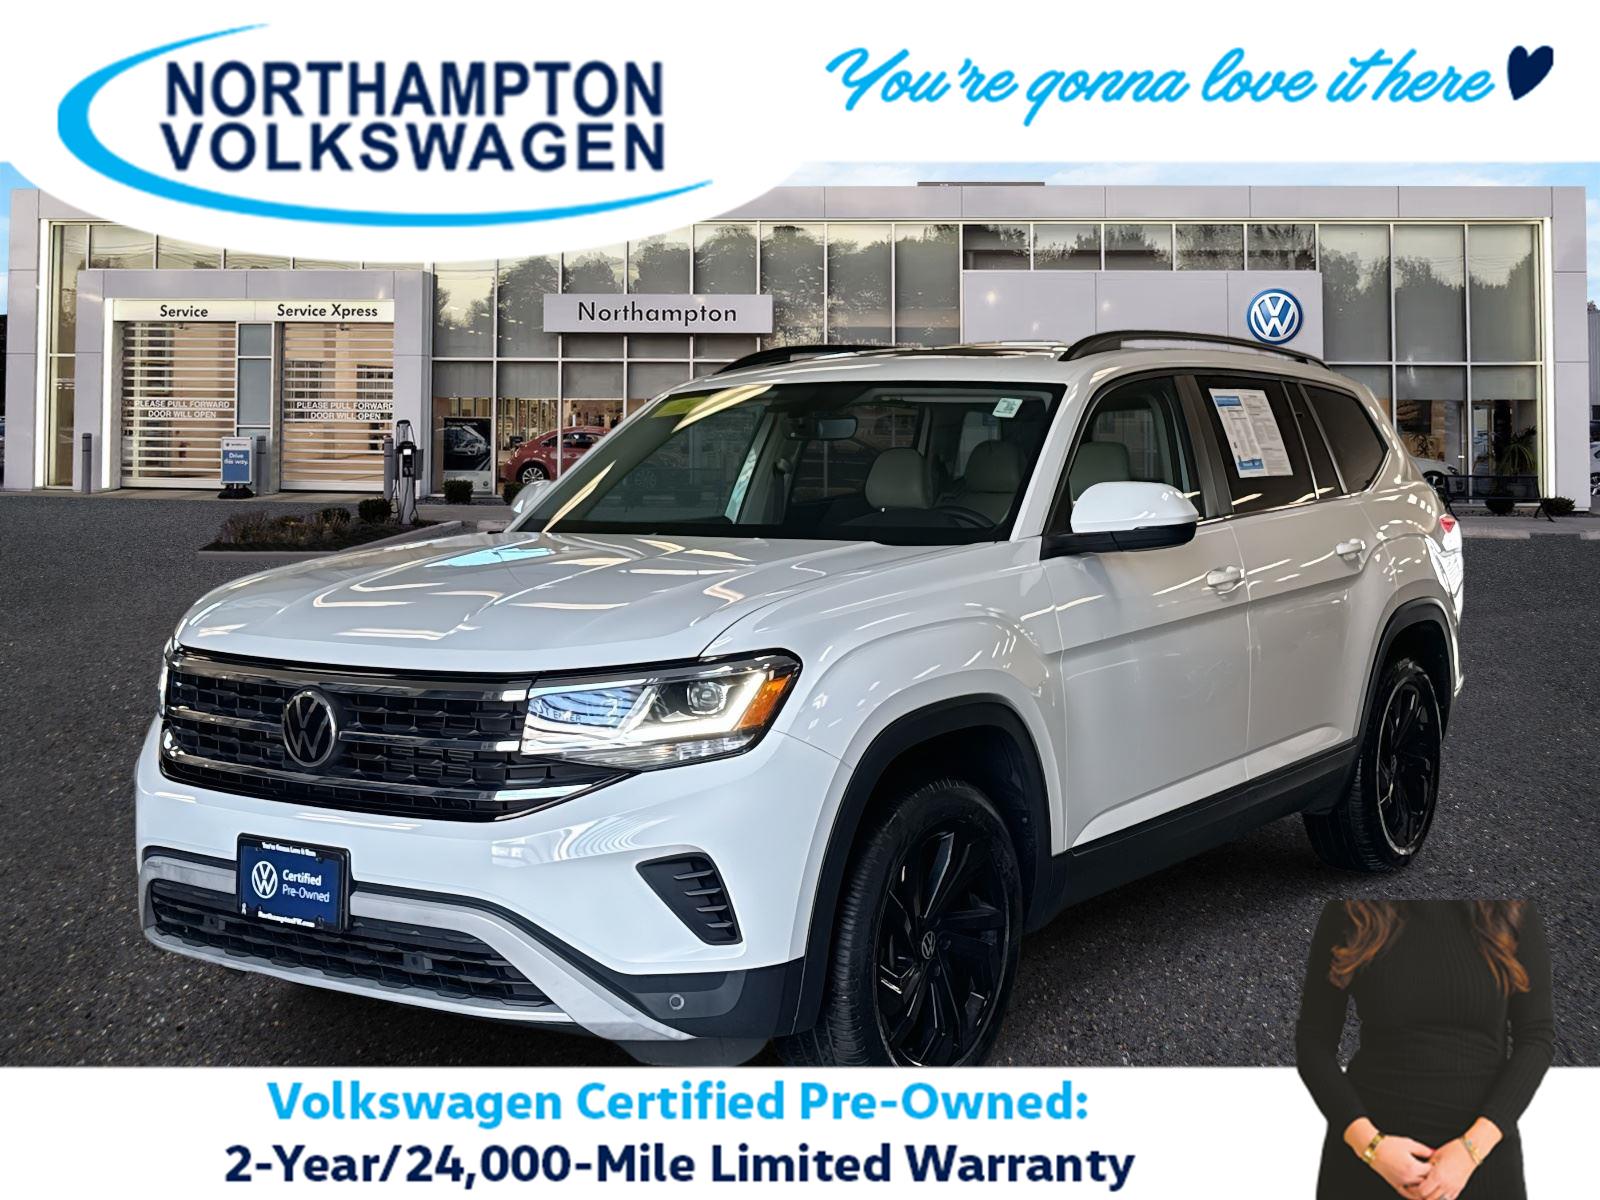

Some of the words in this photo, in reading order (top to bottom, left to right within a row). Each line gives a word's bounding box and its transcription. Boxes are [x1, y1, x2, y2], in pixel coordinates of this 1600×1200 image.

[159, 304, 209, 318] Service
[277, 303, 327, 317] Service
[331, 303, 378, 319] Xpress
[578, 301, 737, 327] Northampton
[134, 399, 166, 408] PLEASE
[167, 400, 188, 408] PULL
[189, 400, 230, 409] FORWARD
[296, 401, 328, 409] PLEASE
[330, 401, 352, 410] PULL
[353, 401, 394, 410] FORWARD
[147, 410, 172, 418] DOOR
[173, 410, 192, 418] WILL
[193, 410, 217, 418] OPEN
[310, 412, 335, 420] DOOR
[336, 412, 356, 420] WILL
[357, 412, 381, 420] OPEN
[282, 869, 322, 887] Certified
[282, 883, 330, 903] Pre-Owned
